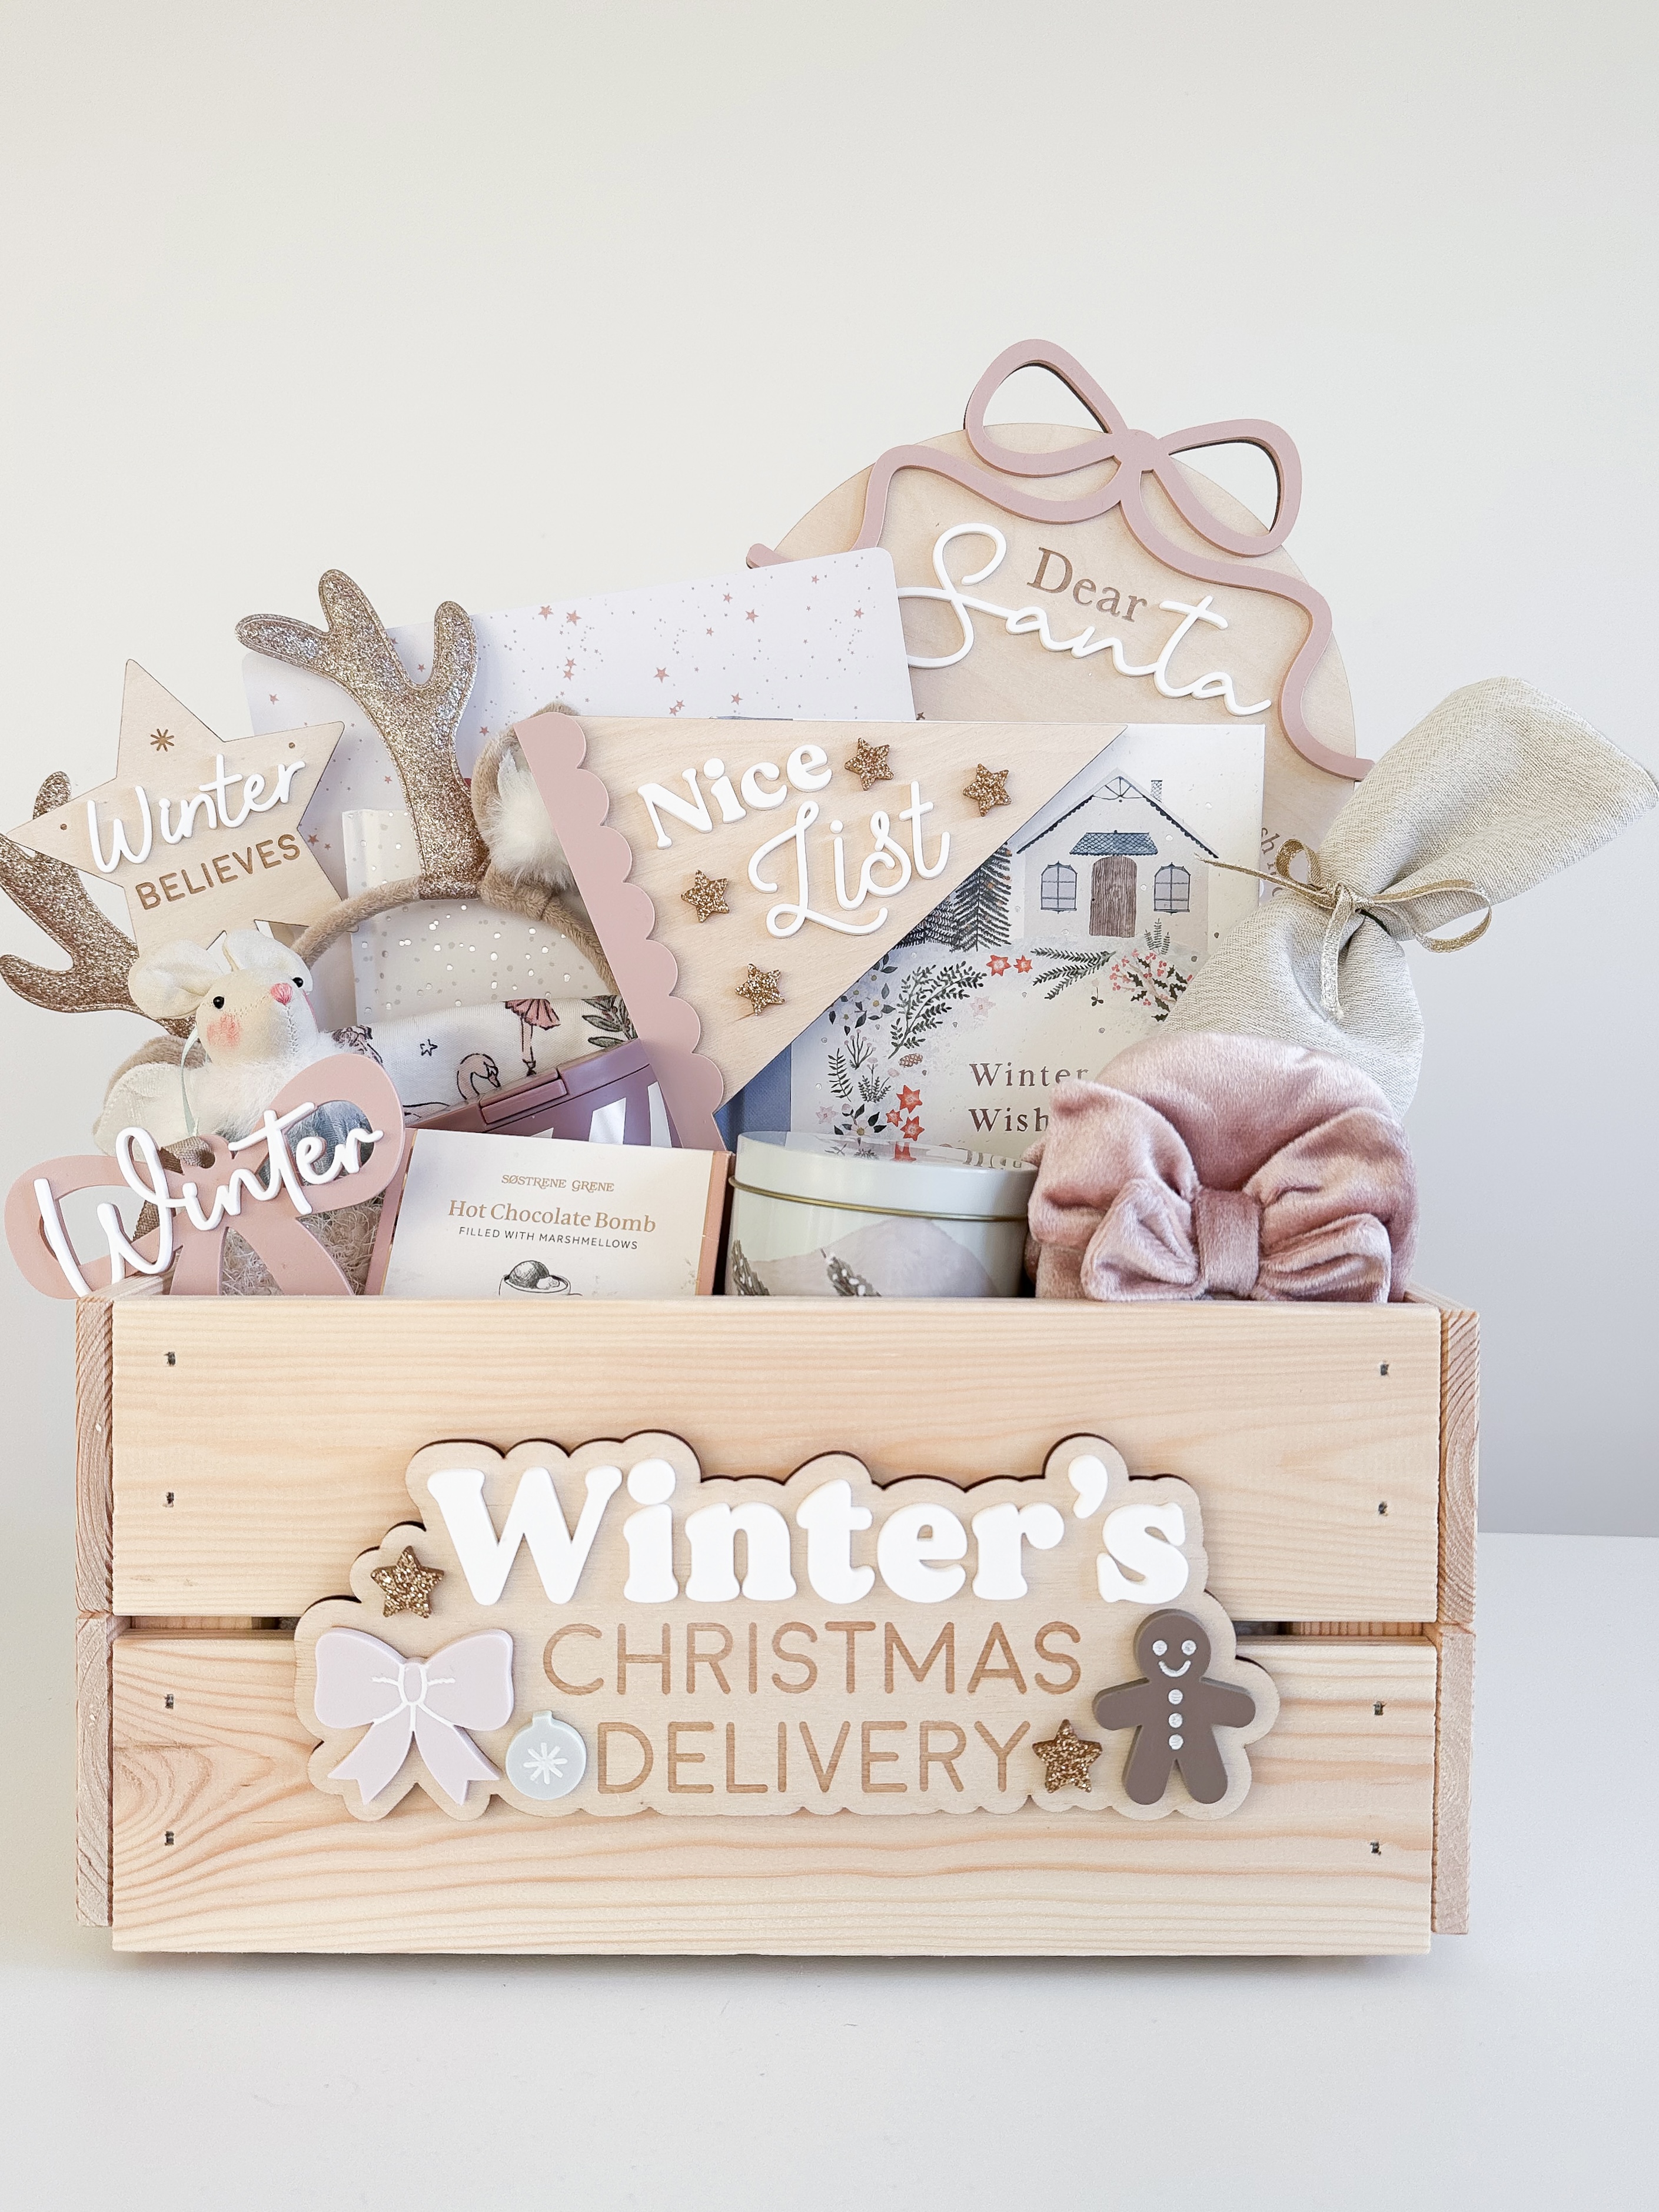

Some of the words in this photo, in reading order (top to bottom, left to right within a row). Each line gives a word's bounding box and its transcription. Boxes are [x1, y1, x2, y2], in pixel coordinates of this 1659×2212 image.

[897, 522, 1272, 717] Santa
[1026, 546, 1148, 623] Dear
[87, 753, 306, 873] Winter
[637, 744, 833, 850] Nice
[135, 834, 301, 910] BELIEVES
[747, 780, 950, 939] List
[969, 1062, 1089, 1087] Winter
[34, 1102, 384, 1295] Winter
[448, 1199, 487, 1219] Hot
[490, 1203, 591, 1228] Chocolate
[594, 1212, 657, 1233] Bomb
[501, 1174, 567, 1189] SØSTRENE
[571, 1180, 615, 1193] GRENE
[458, 1226, 500, 1239] FILLED
[504, 1230, 534, 1242] WITH
[538, 1233, 639, 1250] MARSHMELLOWS
[426, 1455, 1190, 1605] Winter's
[542, 1621, 1082, 1695] CHRISTMAS
[596, 1721, 1031, 1794] DELIVERY
